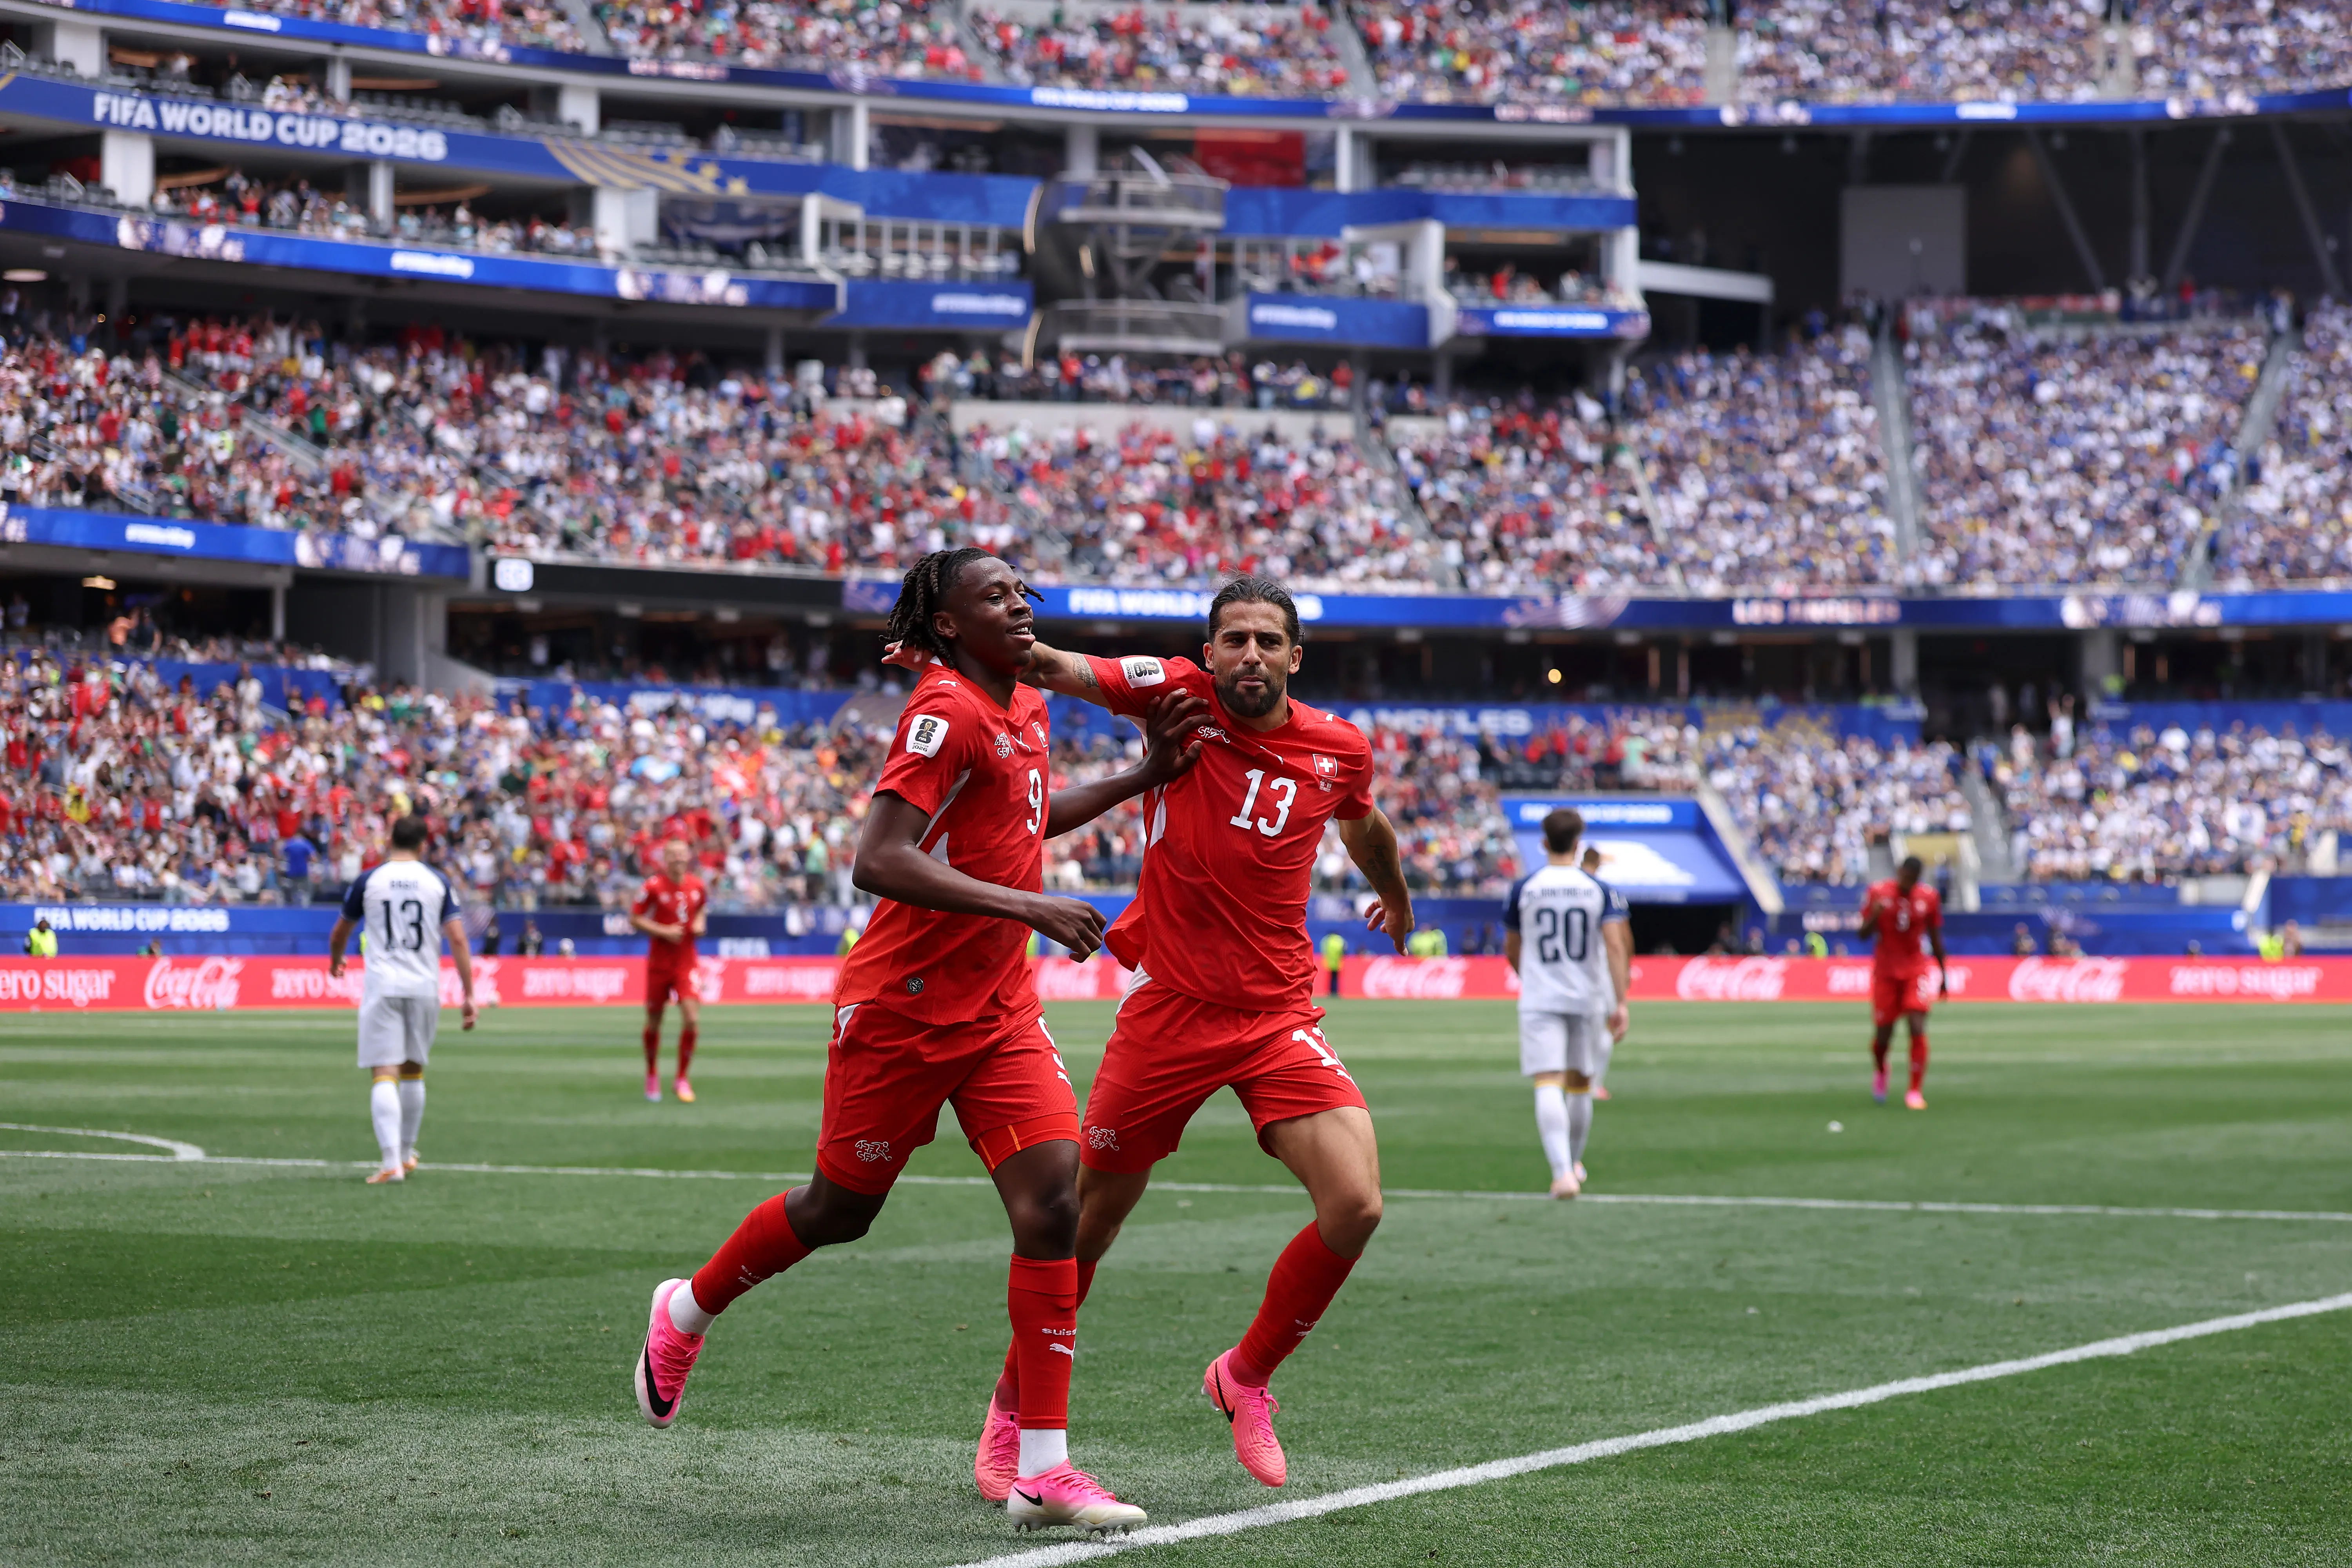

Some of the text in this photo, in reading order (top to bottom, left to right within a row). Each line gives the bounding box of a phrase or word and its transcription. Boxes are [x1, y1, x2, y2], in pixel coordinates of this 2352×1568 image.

[94, 91, 448, 161] FIFA WORLD CUP 2026
[1068, 590, 1118, 615] FIFA
[1027, 768, 1042, 835] 9
[1230, 768, 1297, 837] 13
[72, 907, 135, 931] WORLD
[135, 908, 170, 931] CUP
[170, 908, 230, 932] 2026
[383, 900, 423, 953] 13
[1535, 907, 1587, 963] 20
[44, 968, 116, 1007] sugar
[144, 955, 245, 1009] Coca-Cola
